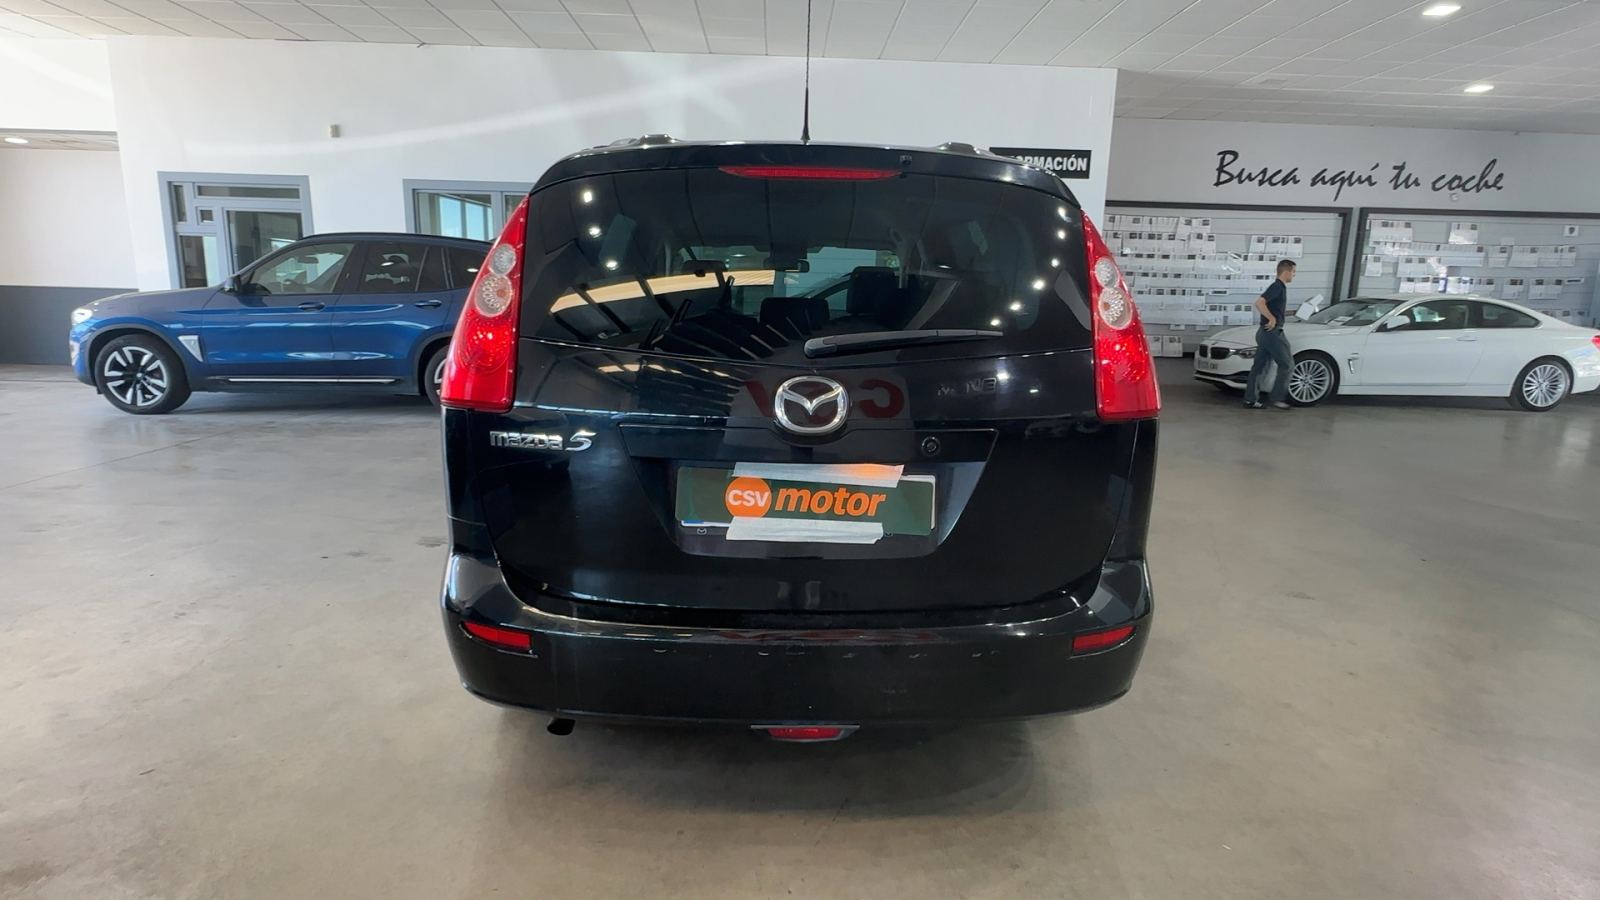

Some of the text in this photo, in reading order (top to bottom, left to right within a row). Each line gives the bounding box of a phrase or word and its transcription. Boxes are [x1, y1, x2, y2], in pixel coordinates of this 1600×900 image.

[1213, 150, 1504, 201] Busca aquí tu coche
[565, 429, 597, 452] 5
[727, 486, 887, 517] CSV motor
